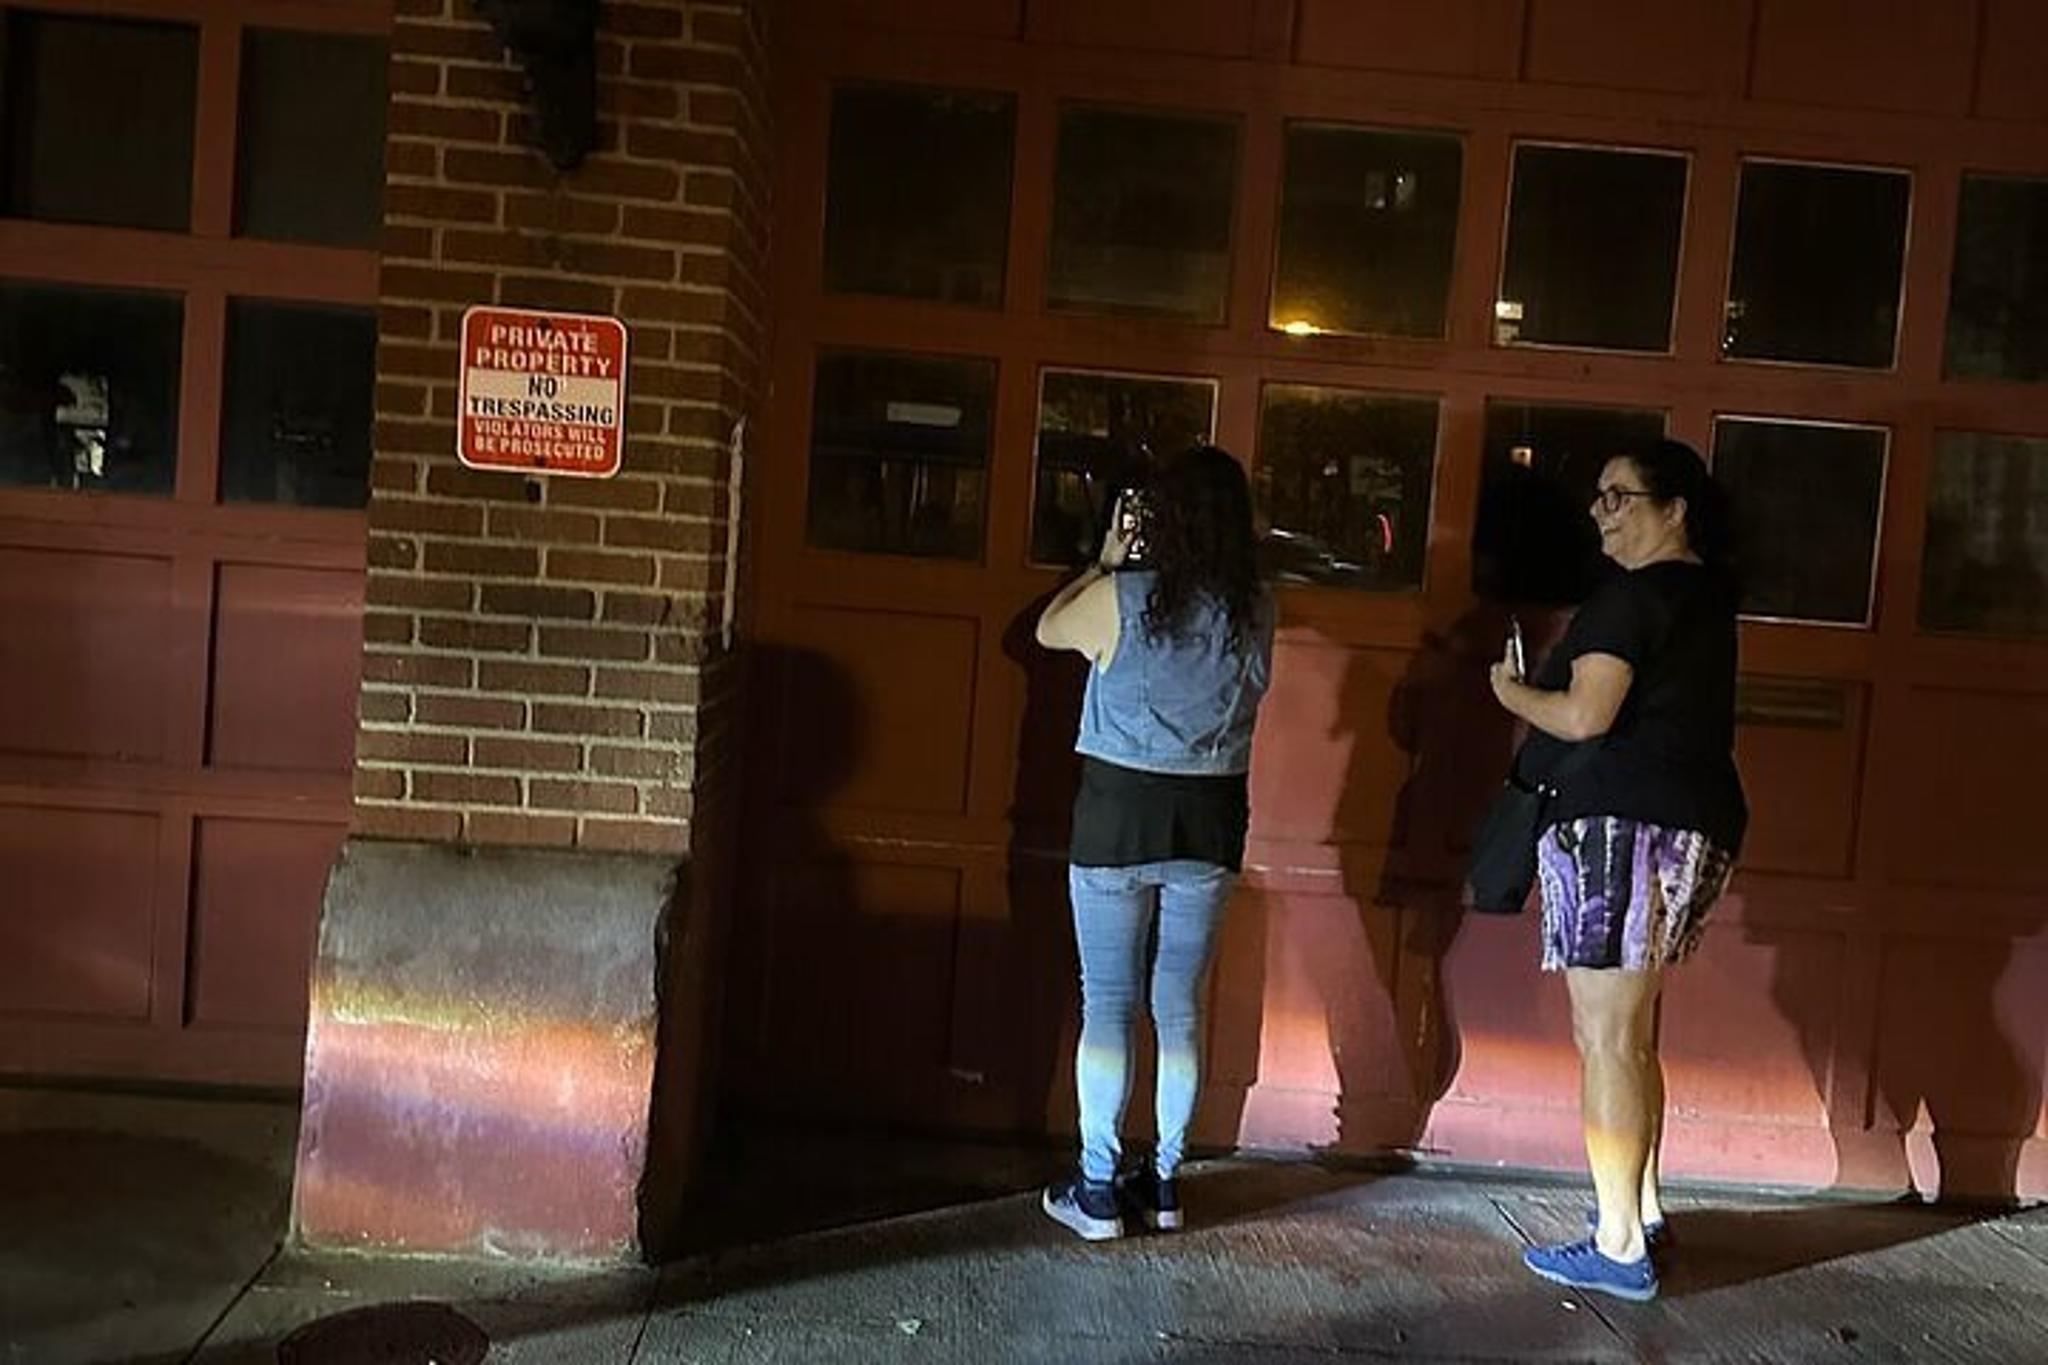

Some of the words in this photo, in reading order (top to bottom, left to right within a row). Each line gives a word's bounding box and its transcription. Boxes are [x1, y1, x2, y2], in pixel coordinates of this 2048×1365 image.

[492, 325, 598, 353] PRIVATE
[478, 347, 610, 376] PROPERTY
[528, 376, 557, 398] NO
[470, 396, 612, 424] TRESPASSING
[474, 420, 563, 438] VIOLATORS
[568, 428, 606, 443] WILL
[475, 435, 495, 451] BE
[500, 438, 604, 459] PROSECUTED
